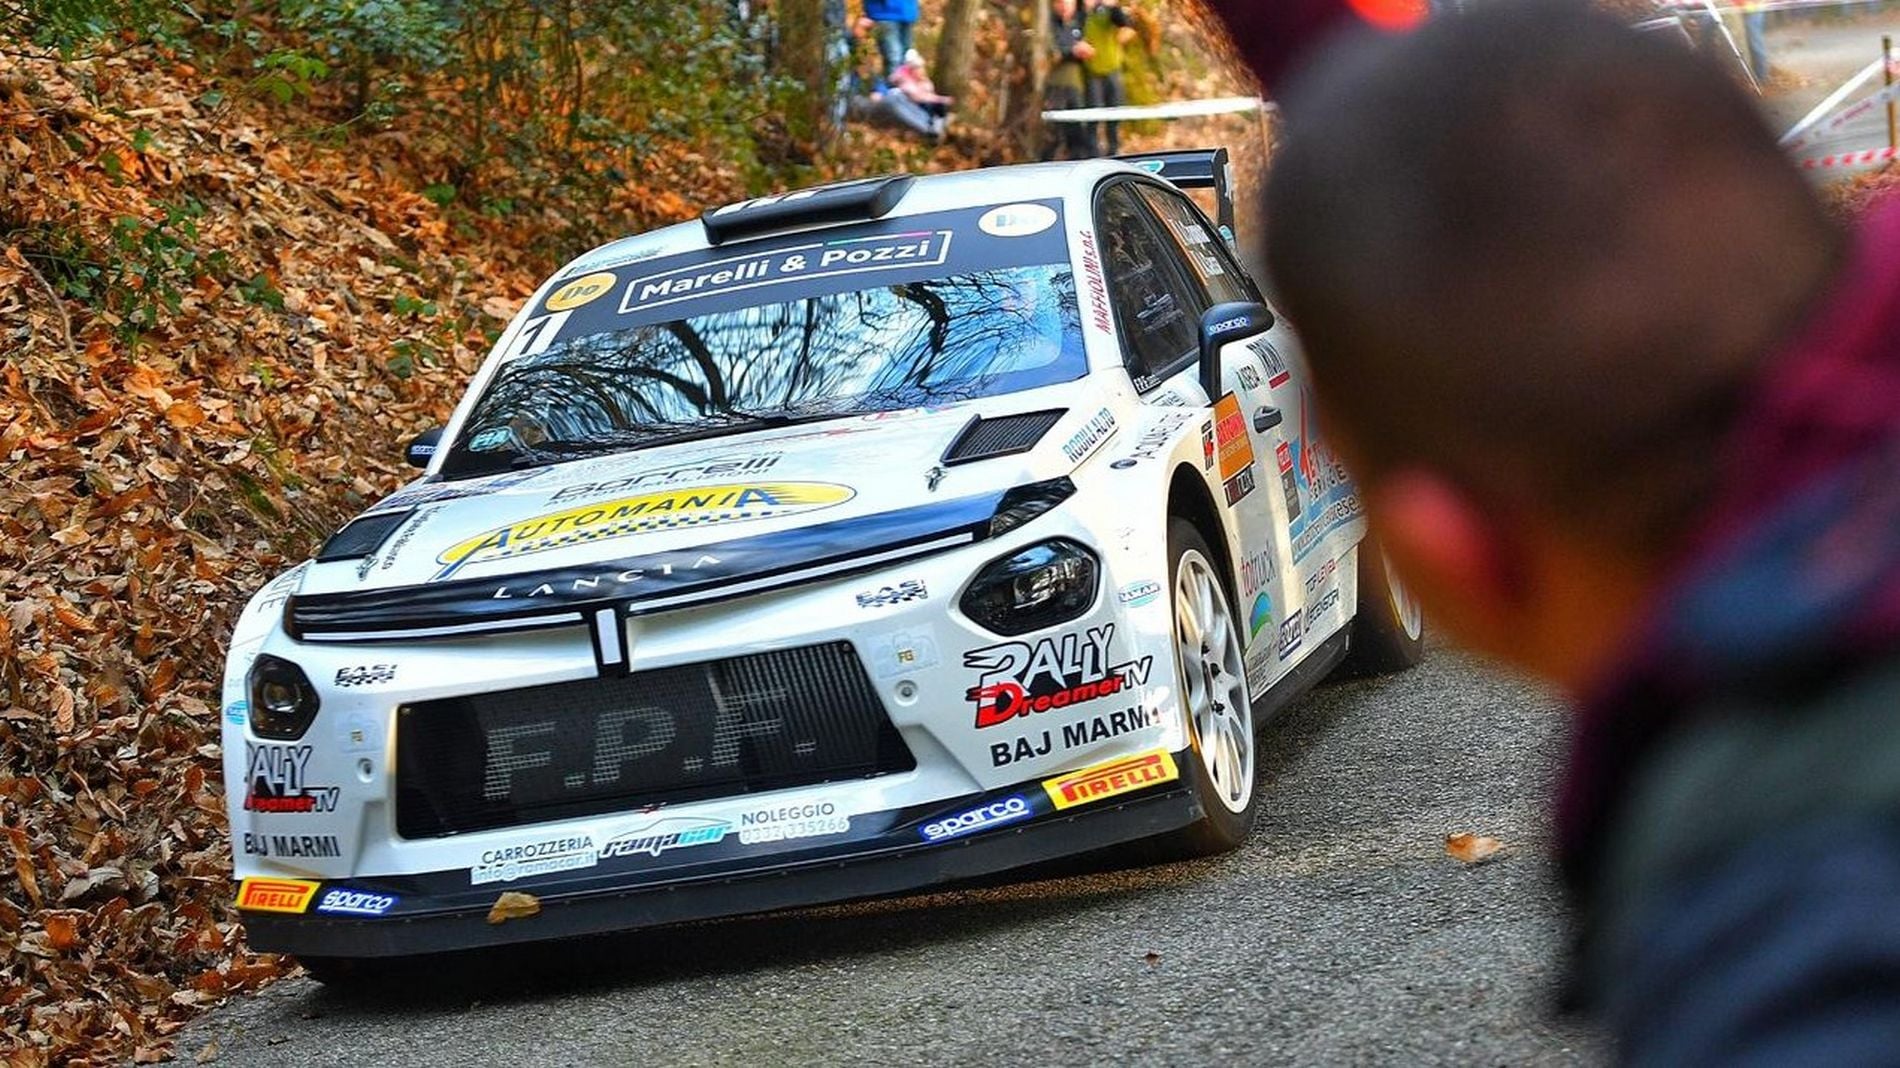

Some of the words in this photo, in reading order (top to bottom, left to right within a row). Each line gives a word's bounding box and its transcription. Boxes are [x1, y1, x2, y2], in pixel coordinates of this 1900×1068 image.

[639, 259, 771, 300] Marelli
[780, 254, 807, 273] &
[821, 240, 930, 267] Pozzi
[478, 486, 783, 549] AUTOMANIA
[492, 554, 721, 599] LANCIA
[963, 623, 1115, 695] RALLY
[965, 674, 1125, 729] Dreamer
[1110, 655, 1153, 690] TV
[484, 688, 818, 801] F.P.F.
[990, 731, 1051, 767] BAJ
[246, 744, 313, 797] ALLY
[1057, 752, 1168, 803] PIRELLI
[741, 802, 835, 827] NOLEGGIO
[923, 797, 1030, 840] sparco
[272, 835, 342, 858] MARMI
[481, 835, 595, 865] CARROZZERIA
[602, 824, 731, 858] ramacar
[473, 853, 595, 882] info@ramacar.it
[243, 882, 312, 909] PIRELLI
[318, 890, 394, 914] sparco
